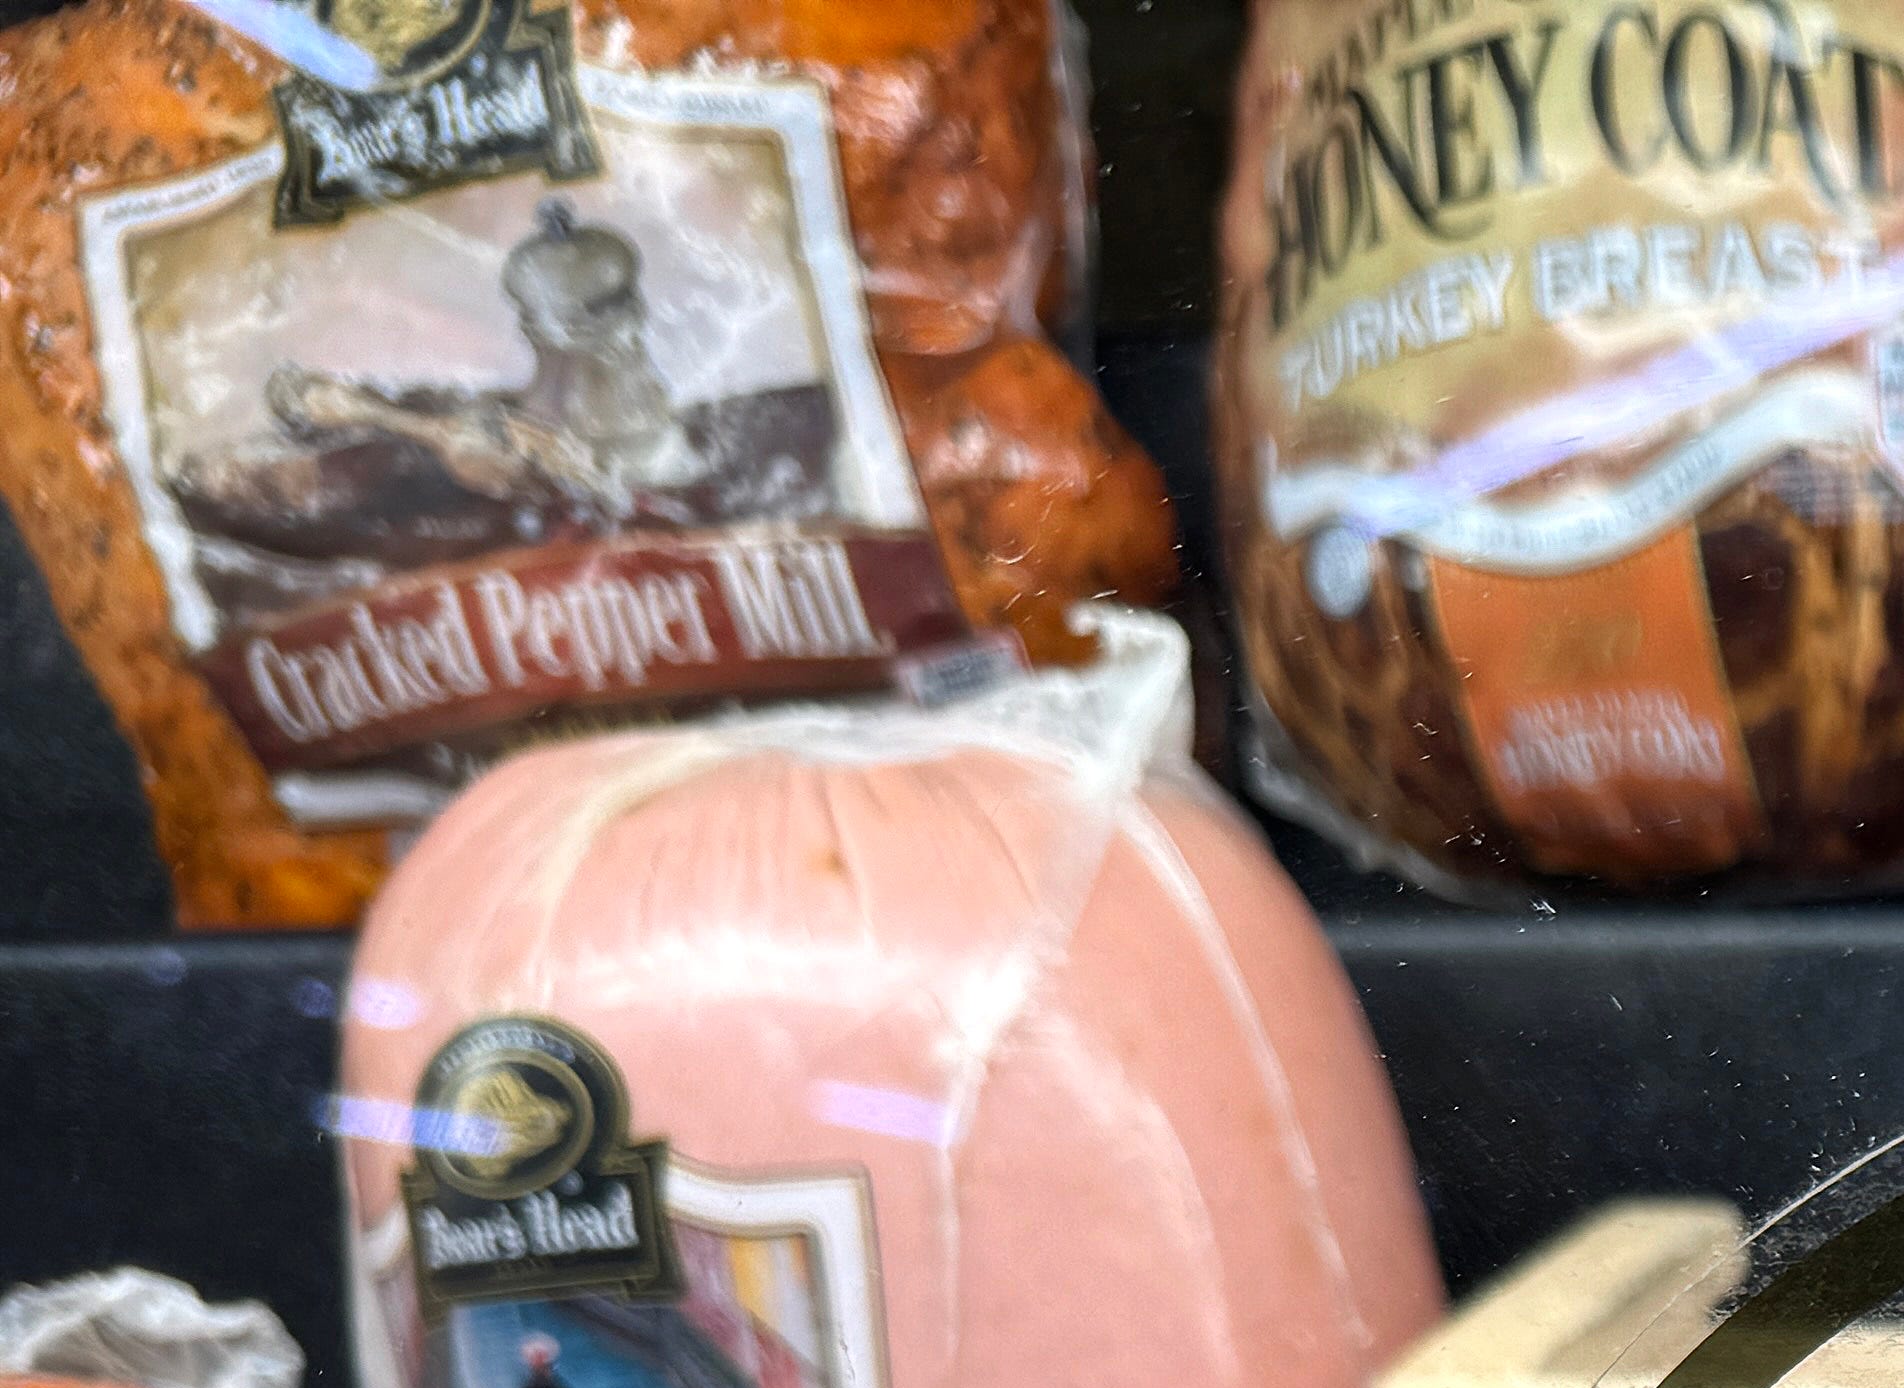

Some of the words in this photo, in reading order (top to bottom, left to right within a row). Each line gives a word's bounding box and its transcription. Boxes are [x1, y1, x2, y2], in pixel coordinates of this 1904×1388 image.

[1279, 248, 1516, 405] TURKEY
[1532, 219, 1880, 322] BREAST
[248, 584, 488, 742] Cracked
[474, 566, 718, 690] Pepper
